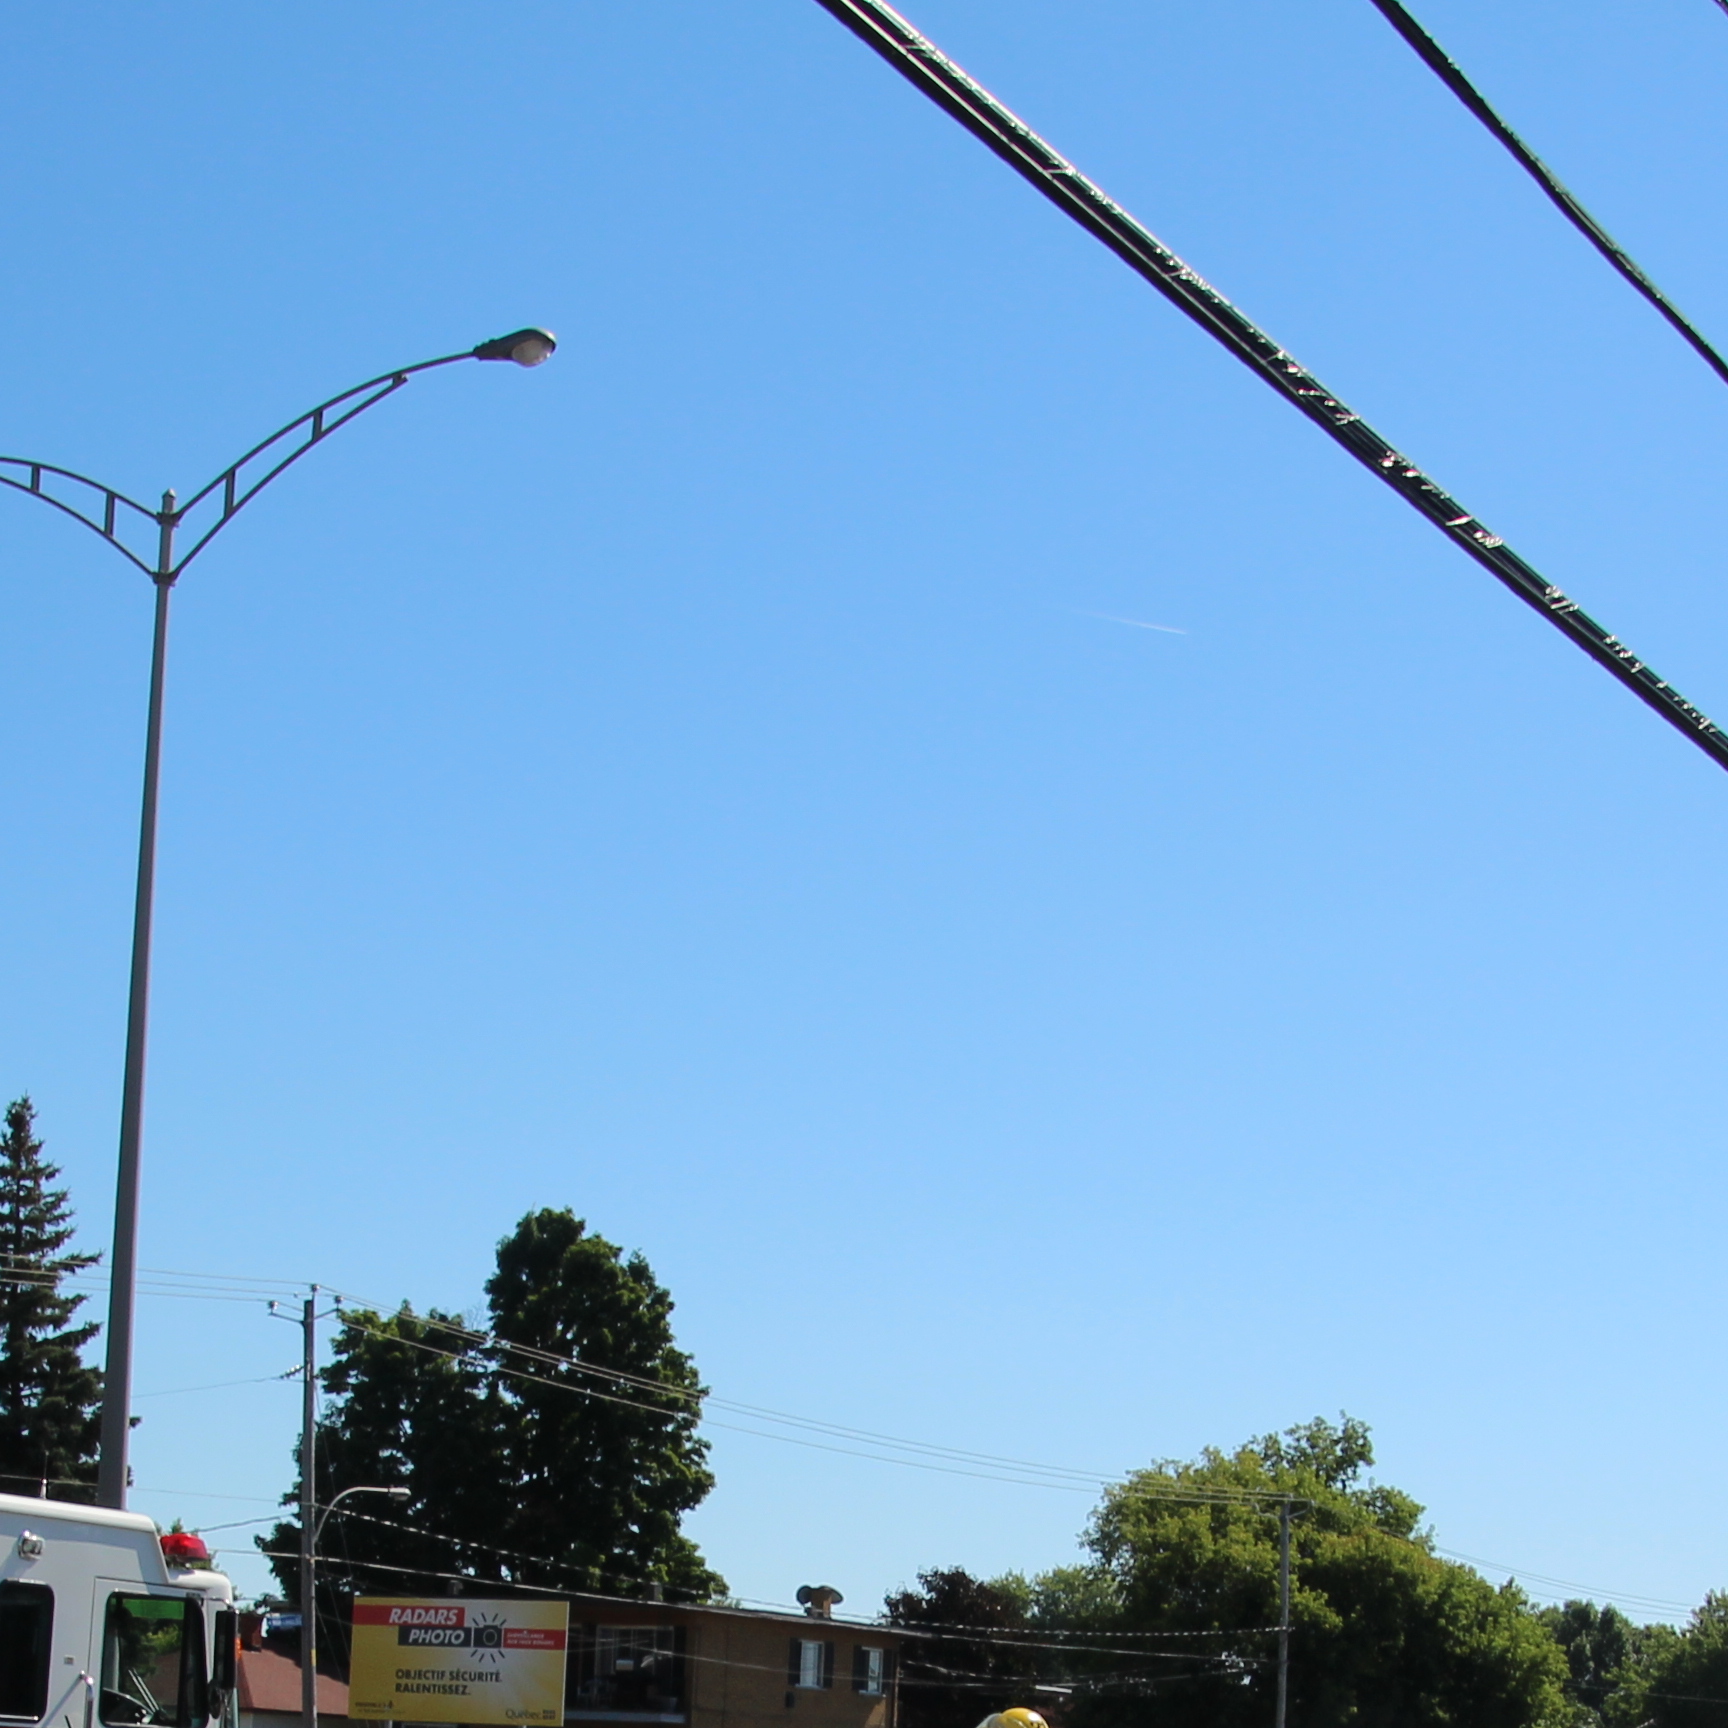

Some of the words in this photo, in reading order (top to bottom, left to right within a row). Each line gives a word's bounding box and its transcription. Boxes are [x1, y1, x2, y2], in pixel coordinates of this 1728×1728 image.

[389, 1607, 459, 1625] RADARS
[408, 1629, 466, 1645] PHOTO
[395, 1668, 446, 1682] OBJECTIF
[395, 1682, 471, 1696] RALENTISSEZ.
